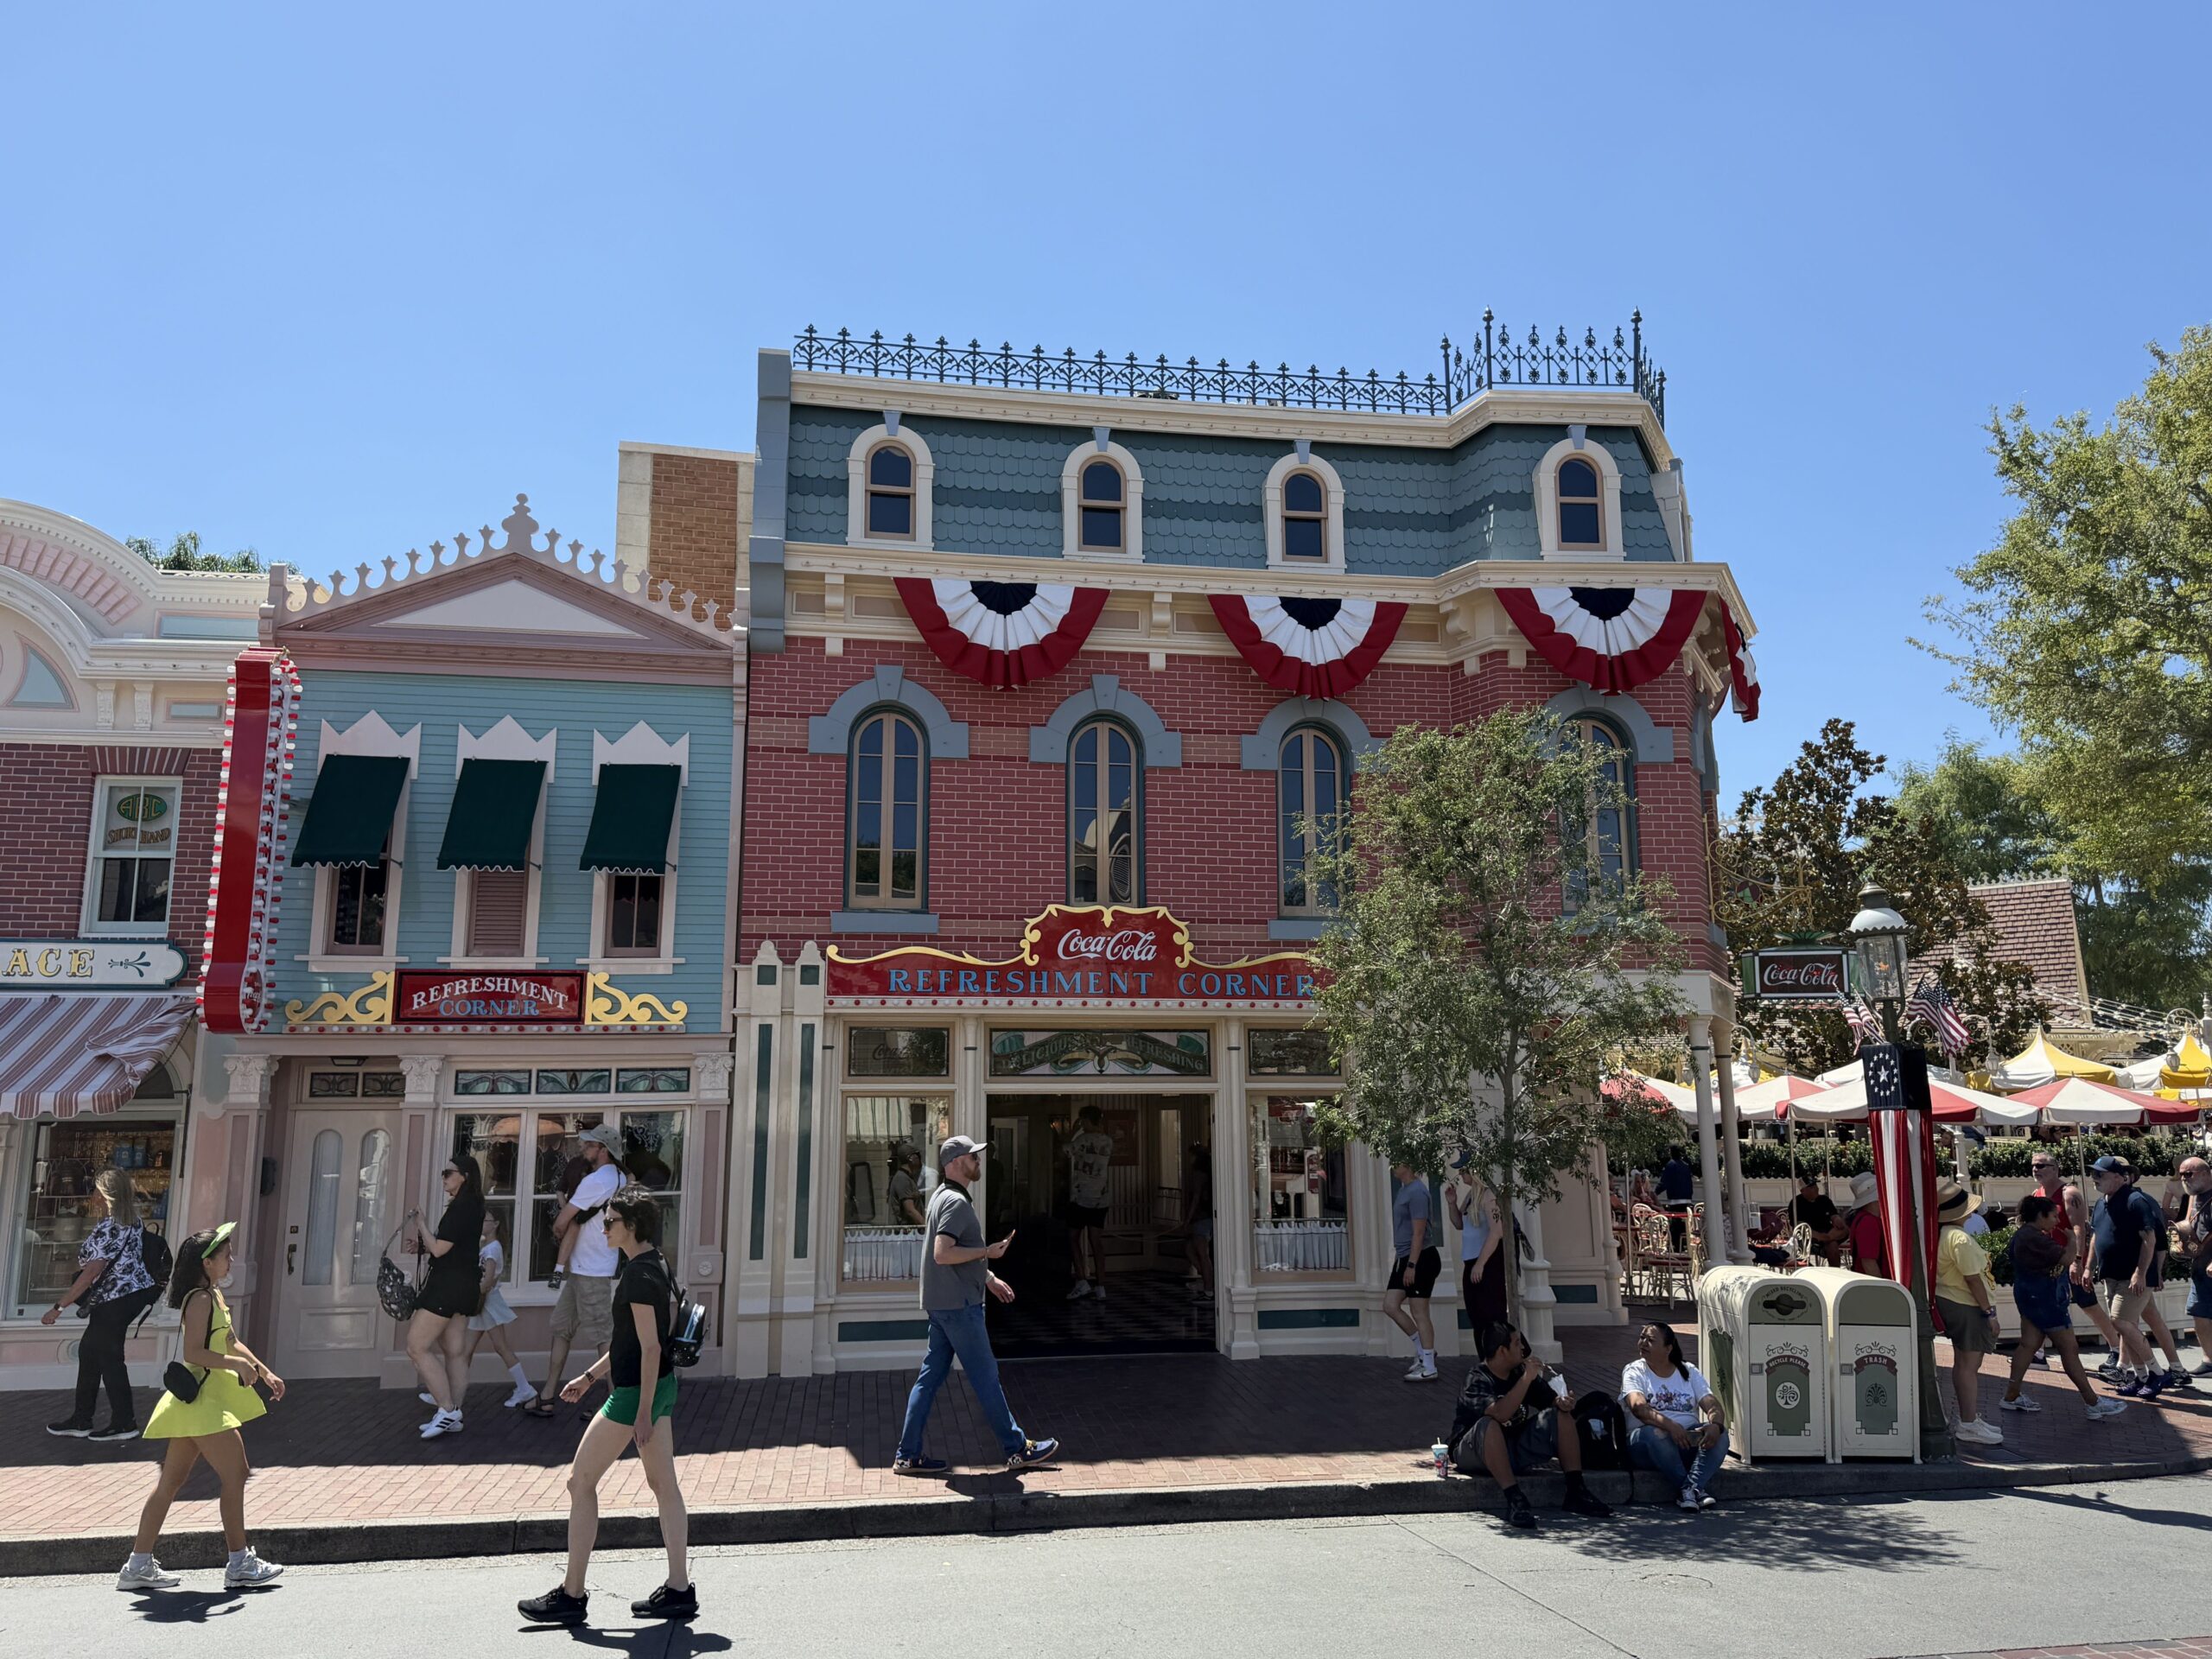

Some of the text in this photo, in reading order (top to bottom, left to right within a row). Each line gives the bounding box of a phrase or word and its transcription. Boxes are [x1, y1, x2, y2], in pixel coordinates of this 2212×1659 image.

[119, 796, 162, 820] ABC
[1057, 928, 1158, 961] Coca-Cola
[2, 949, 95, 978] ACE
[1763, 963, 1840, 986] Coca-Cola
[411, 976, 569, 1010] REFRESHMENT
[887, 969, 1315, 997] REFRESHMENT CORNER
[439, 999, 540, 1016] CORNER
[1769, 1357, 1807, 1368] RECYCLE PLEASE
